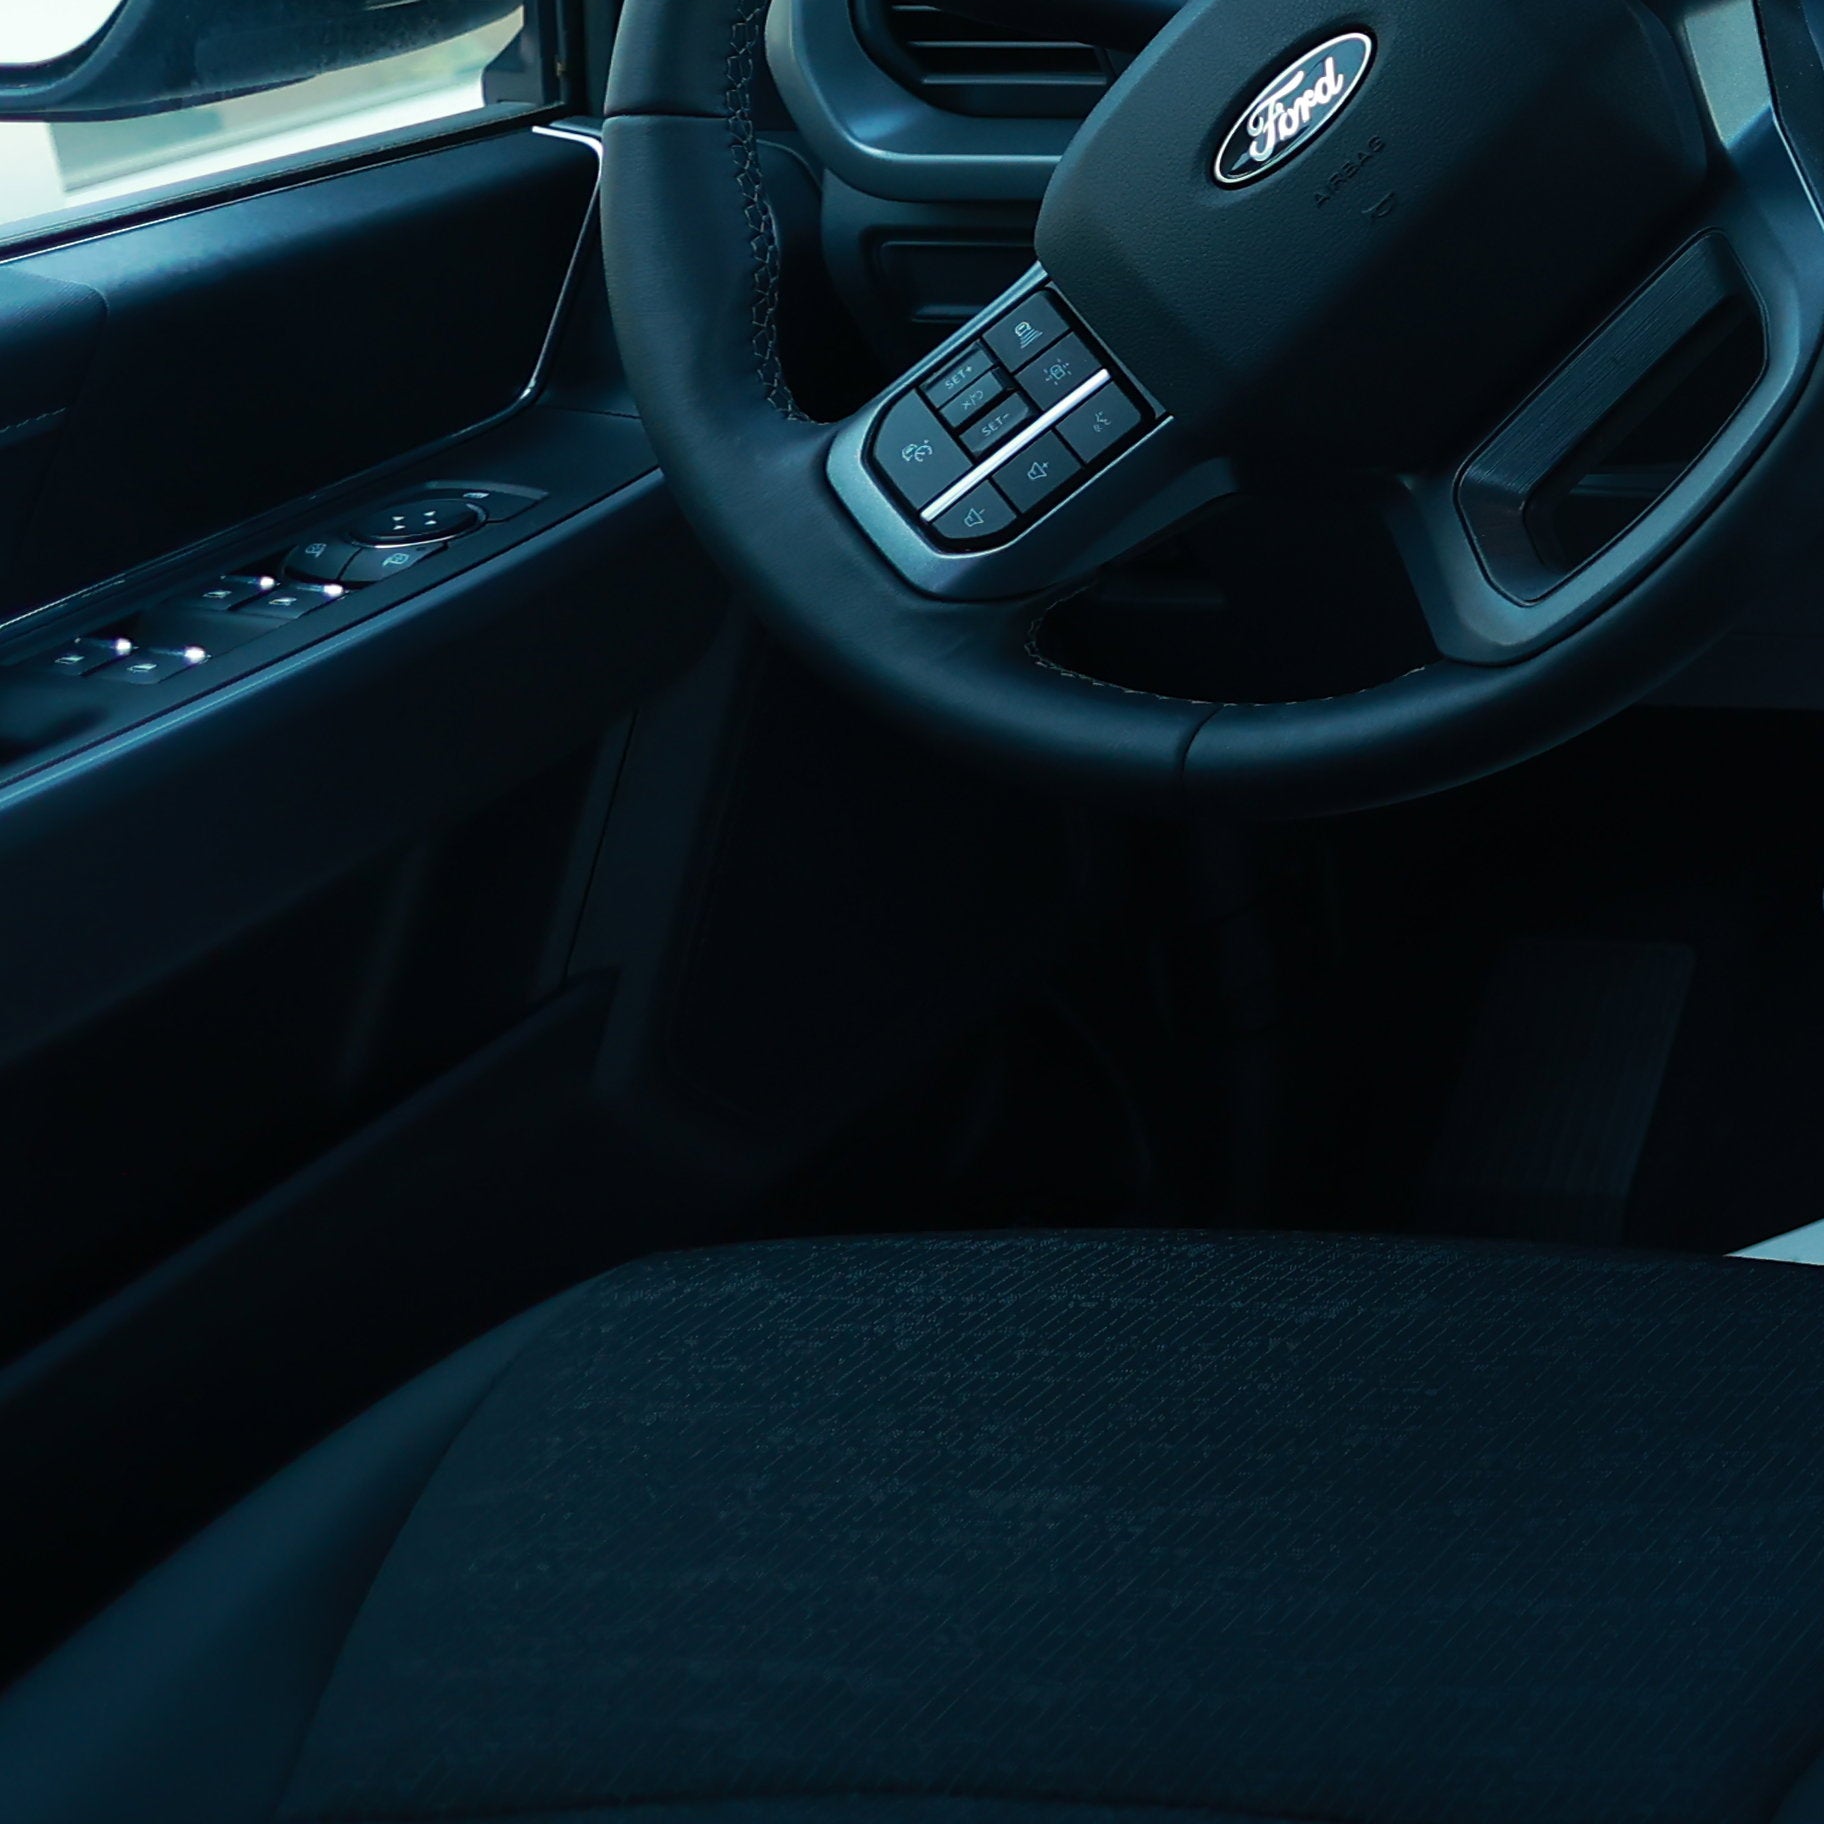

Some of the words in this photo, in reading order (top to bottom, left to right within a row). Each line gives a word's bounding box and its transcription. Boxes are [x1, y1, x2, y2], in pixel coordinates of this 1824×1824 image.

[1246, 56, 1344, 162] Ford
[1313, 134, 1385, 209] AIRBAG
[944, 365, 973, 390] SET+
